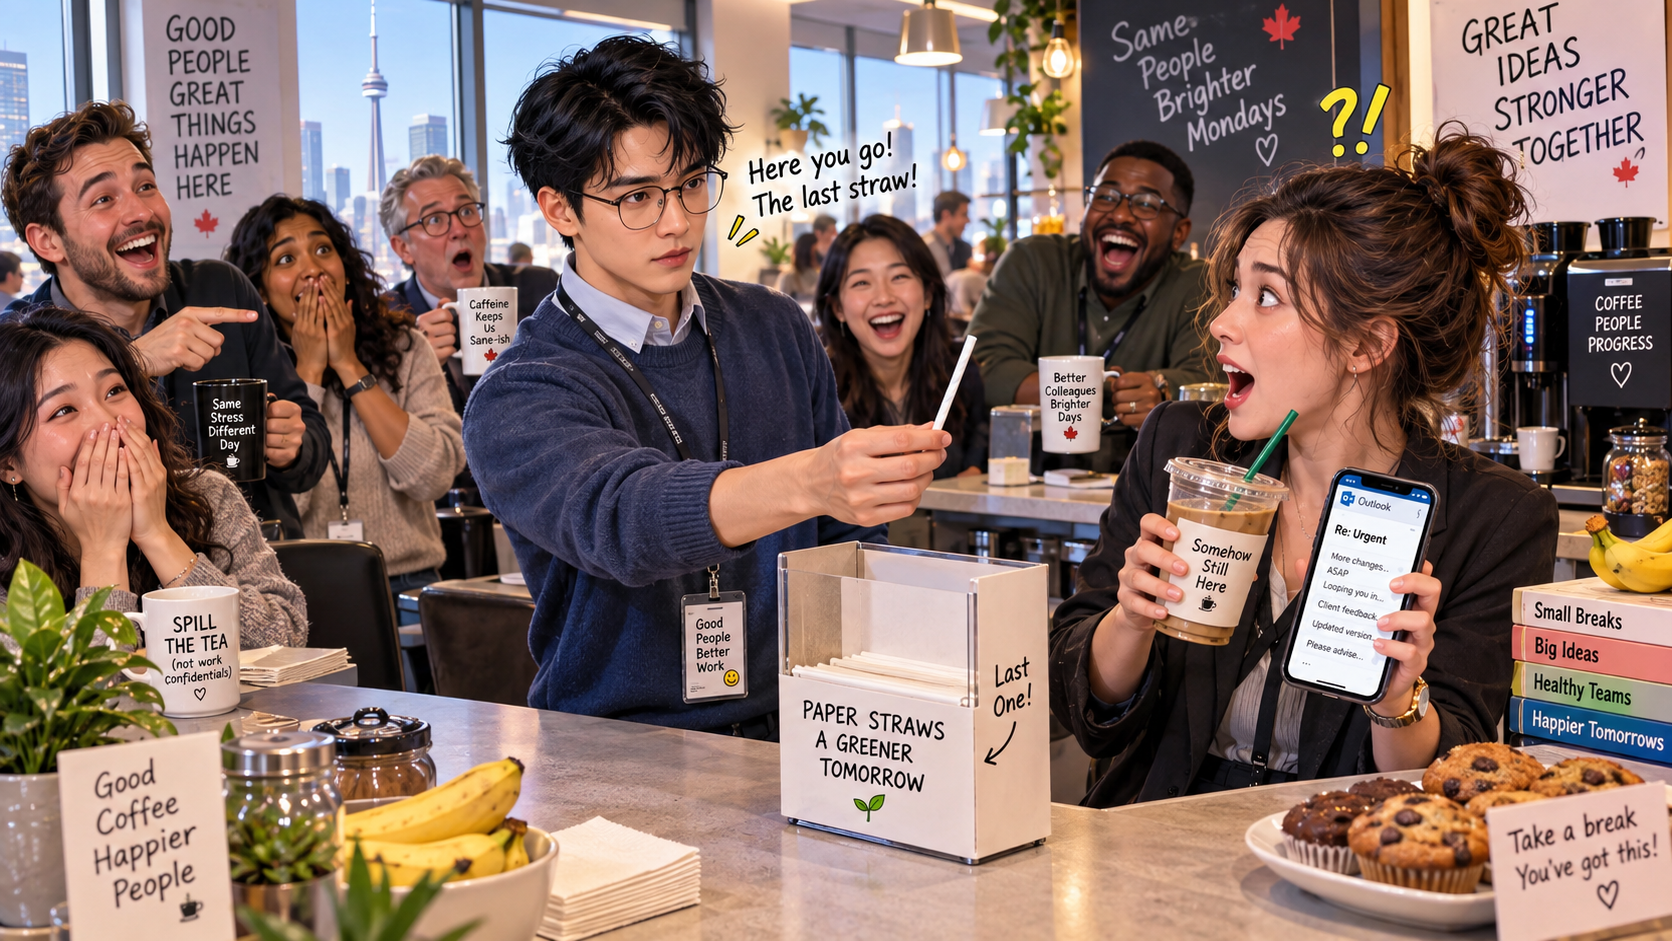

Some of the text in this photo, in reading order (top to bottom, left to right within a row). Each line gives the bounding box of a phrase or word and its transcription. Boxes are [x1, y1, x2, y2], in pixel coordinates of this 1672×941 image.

[166, 14, 236, 42] GOOD
[1111, 15, 1190, 62] Same
[1462, 2, 1559, 56] GREAT
[168, 49, 250, 76] PEOPLE
[1137, 38, 1216, 90] People
[1498, 36, 1580, 86] IDEAS
[170, 80, 244, 107] GREAT
[1153, 64, 1256, 122] Brighter
[1494, 68, 1630, 131] STRONGER
[170, 110, 256, 138] THINGS
[1186, 94, 1286, 152] Mondays
[1512, 112, 1644, 166] TOGETHER
[174, 140, 258, 169] HAPPEN
[177, 172, 232, 200] HERE
[470, 299, 509, 310] Caffeine
[1595, 294, 1642, 311] COFFEE
[476, 312, 503, 322] Keeps
[1596, 315, 1642, 332] PEOPLE
[484, 324, 496, 332] Us
[470, 334, 510, 346] Sane-ish
[1588, 335, 1653, 353] PROGRESS
[1054, 372, 1086, 382] Better
[1045, 386, 1096, 398] Colleagues
[212, 398, 242, 410] Same
[1050, 399, 1091, 412] Brighter
[210, 412, 244, 423] Stress
[1058, 412, 1082, 424] Days
[208, 424, 256, 437] Different
[220, 439, 240, 452] Day
[1358, 496, 1392, 512] Outlook
[1334, 524, 1387, 545] Re: Urgent
[1192, 538, 1252, 562] Somehow
[1330, 552, 1351, 564] More
[1202, 559, 1229, 576] Still
[1326, 566, 1349, 577] ASAP
[1196, 575, 1226, 594] Here
[1322, 580, 1354, 596] Looping
[1354, 590, 1369, 598] you
[1318, 600, 1340, 612] Client
[1534, 602, 1622, 630] Small Breaks
[173, 614, 216, 633] SPILL
[696, 616, 723, 630] Good
[1312, 620, 1344, 634] Updated
[164, 633, 228, 654] THE TEA
[696, 632, 730, 645] People
[1306, 639, 1332, 652] Please
[696, 648, 730, 659] Better
[1535, 636, 1599, 663] Big Ideas
[172, 655, 222, 671] (not work
[696, 660, 724, 672] Work
[994, 656, 1030, 688] Last
[165, 666, 232, 685] confidentials)
[993, 682, 1032, 718] One!
[1534, 673, 1632, 706] Healthy Teams
[803, 700, 945, 740] PAPER STRAWS
[1532, 710, 1664, 752] Happier Tomorrows
[816, 730, 913, 764] A GREENER
[94, 757, 156, 799] Good
[820, 758, 925, 792] TOMORROW
[96, 796, 179, 836] Coffee
[1507, 804, 1638, 854] Take a break
[94, 826, 197, 875] Happier
[1515, 832, 1658, 890] You've got this!
[113, 860, 196, 908] People
